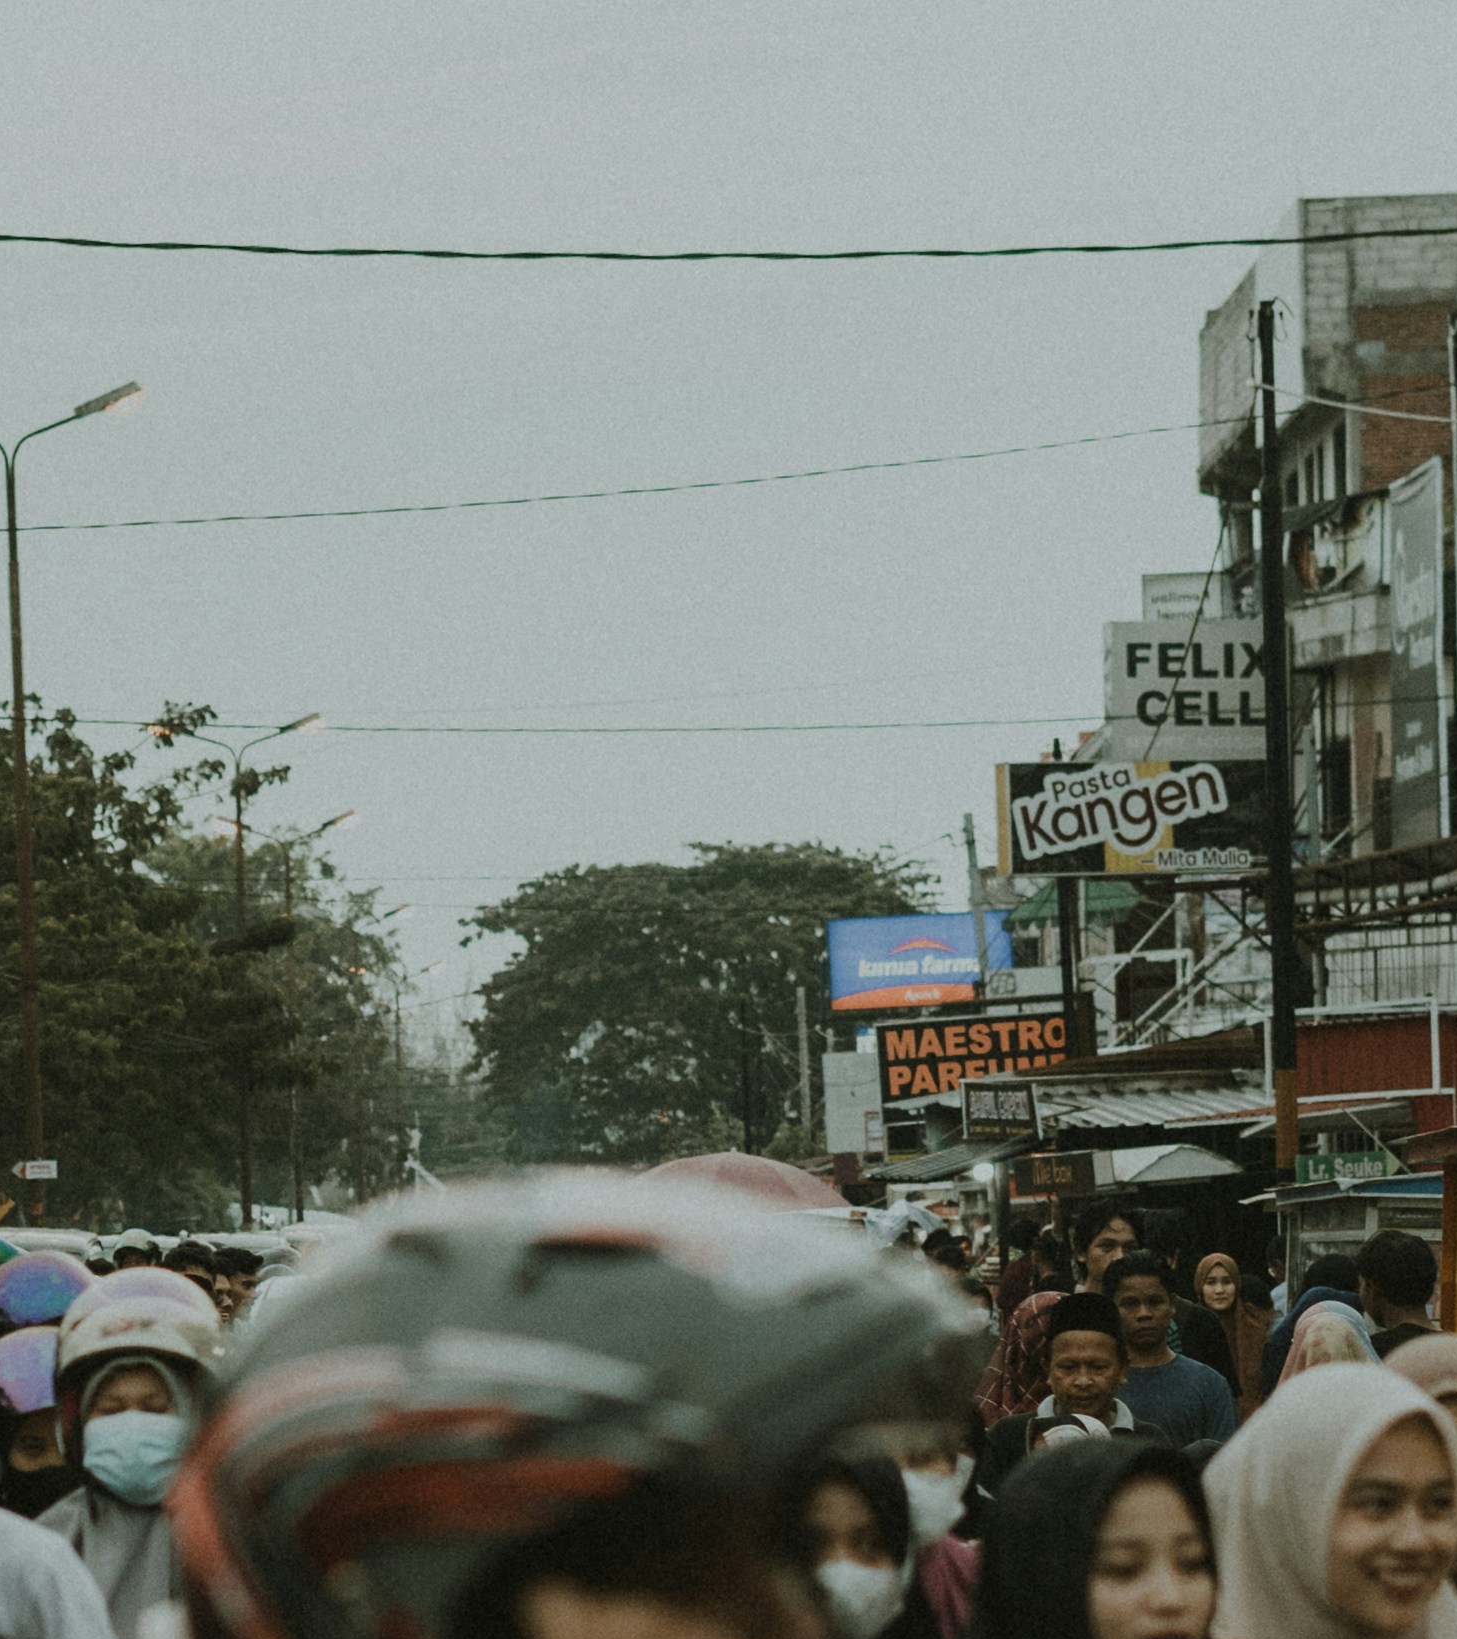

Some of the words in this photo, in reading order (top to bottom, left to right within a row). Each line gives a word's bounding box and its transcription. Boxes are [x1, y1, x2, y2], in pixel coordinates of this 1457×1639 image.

[1127, 643, 1266, 679] FELIX
[1137, 690, 1266, 726] CELL
[1052, 768, 1131, 802] Pasta
[1021, 771, 1220, 850] Kangen
[1158, 852, 1197, 867] Mita
[1202, 851, 1249, 867] Mulia
[885, 1018, 1065, 1061] MAESTRO
[1308, 1160, 1330, 1180] Lr.
[1334, 1157, 1384, 1179] Seuke
